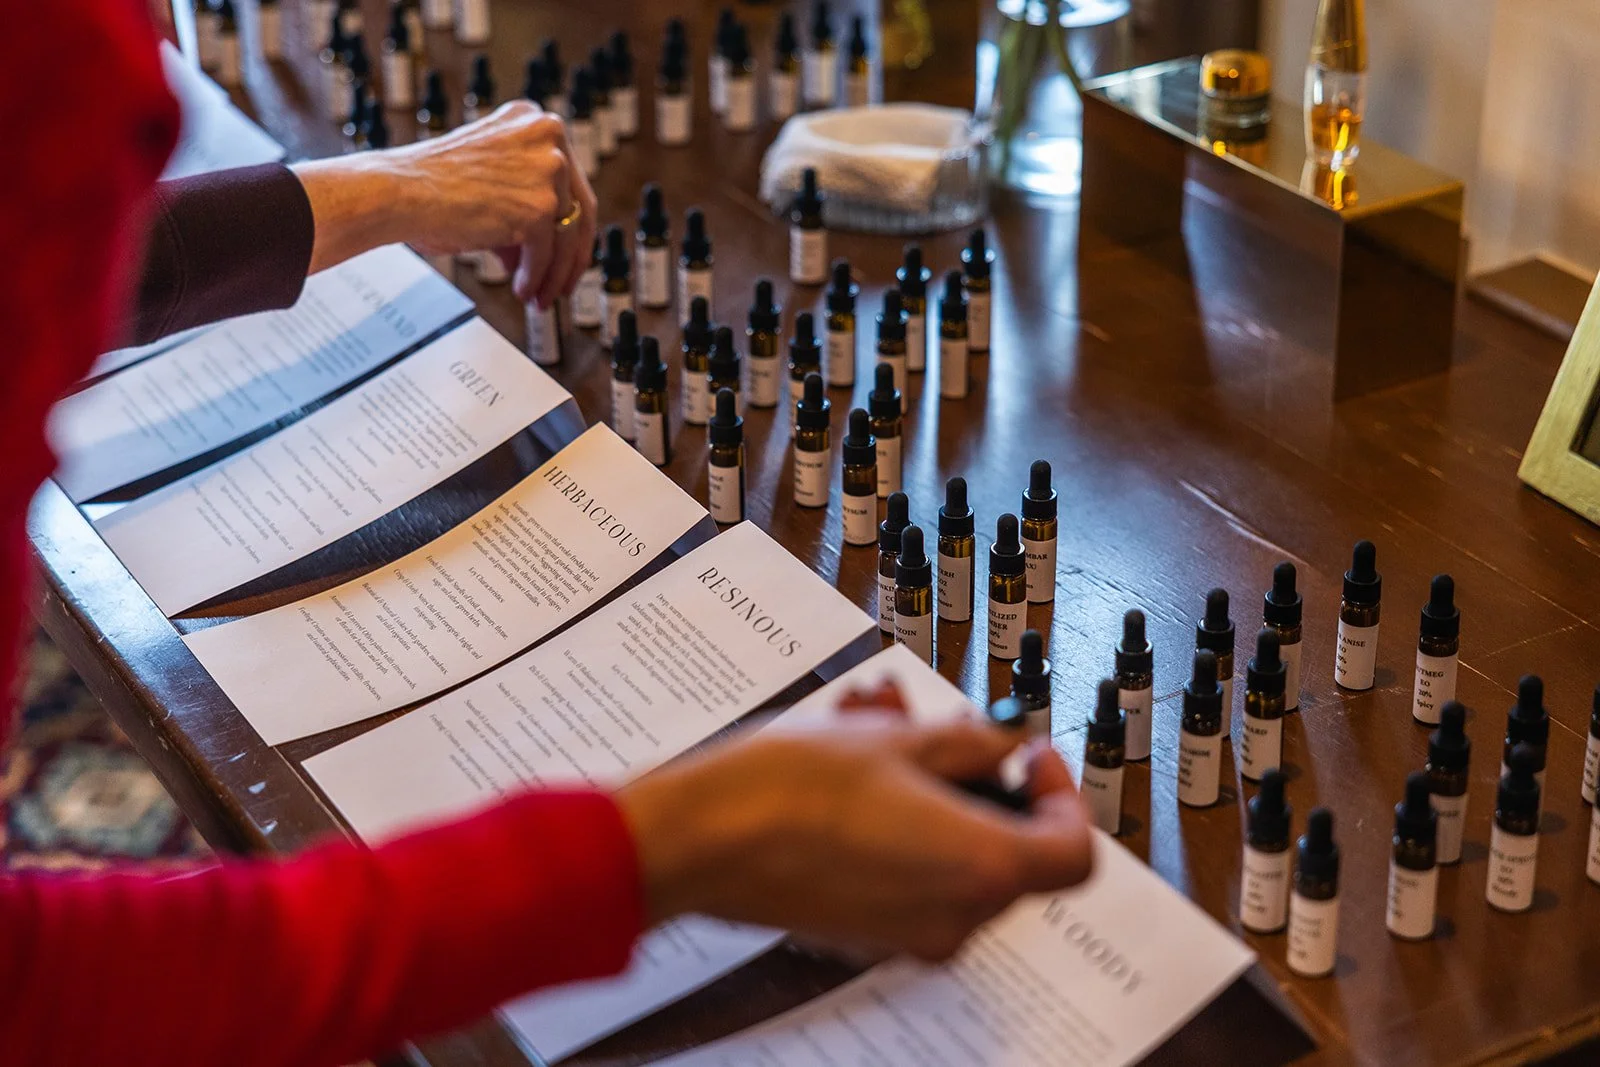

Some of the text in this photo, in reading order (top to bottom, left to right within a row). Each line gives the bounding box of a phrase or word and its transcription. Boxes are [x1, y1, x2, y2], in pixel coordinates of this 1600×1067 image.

[450, 360, 504, 407] GREEN
[543, 465, 647, 557] HERBACEOUS
[488, 556, 499, 564] and
[491, 528, 502, 536] and
[499, 534, 513, 548] slightly
[510, 547, 522, 558] spicy
[528, 563, 552, 584] Associated
[547, 582, 559, 592] with
[518, 540, 530, 548] and
[538, 556, 561, 580] Suggesting
[526, 517, 541, 529] green
[538, 527, 553, 540] scents
[550, 537, 562, 547] that
[558, 545, 572, 556] evoke
[569, 554, 585, 570] freshly
[581, 568, 600, 582] picked
[534, 538, 545, 546] and
[541, 543, 559, 561] fragrant
[425, 555, 439, 567] Fresh
[451, 581, 466, 595] Smells
[468, 566, 477, 576] Key
[483, 536, 494, 544] and
[519, 571, 531, 582] often
[529, 579, 544, 593] found
[493, 563, 508, 575] green
[506, 572, 526, 592] fragrance
[440, 587, 452, 595] and
[447, 594, 459, 605] other
[455, 604, 470, 616] green
[697, 566, 803, 659] RESINOUS
[306, 633, 318, 641] and
[382, 621, 395, 631] wild
[393, 616, 408, 631] Evokes
[405, 628, 418, 640] herb
[416, 593, 429, 606] Notes
[426, 603, 437, 613] that
[433, 611, 446, 621] feel
[471, 651, 483, 659] and
[694, 630, 706, 640] that
[369, 641, 388, 655] paired
[383, 654, 395, 664] with
[1342, 637, 1366, 648] ANISE
[367, 654, 380, 662] and
[1417, 699, 1435, 710] Spicy
